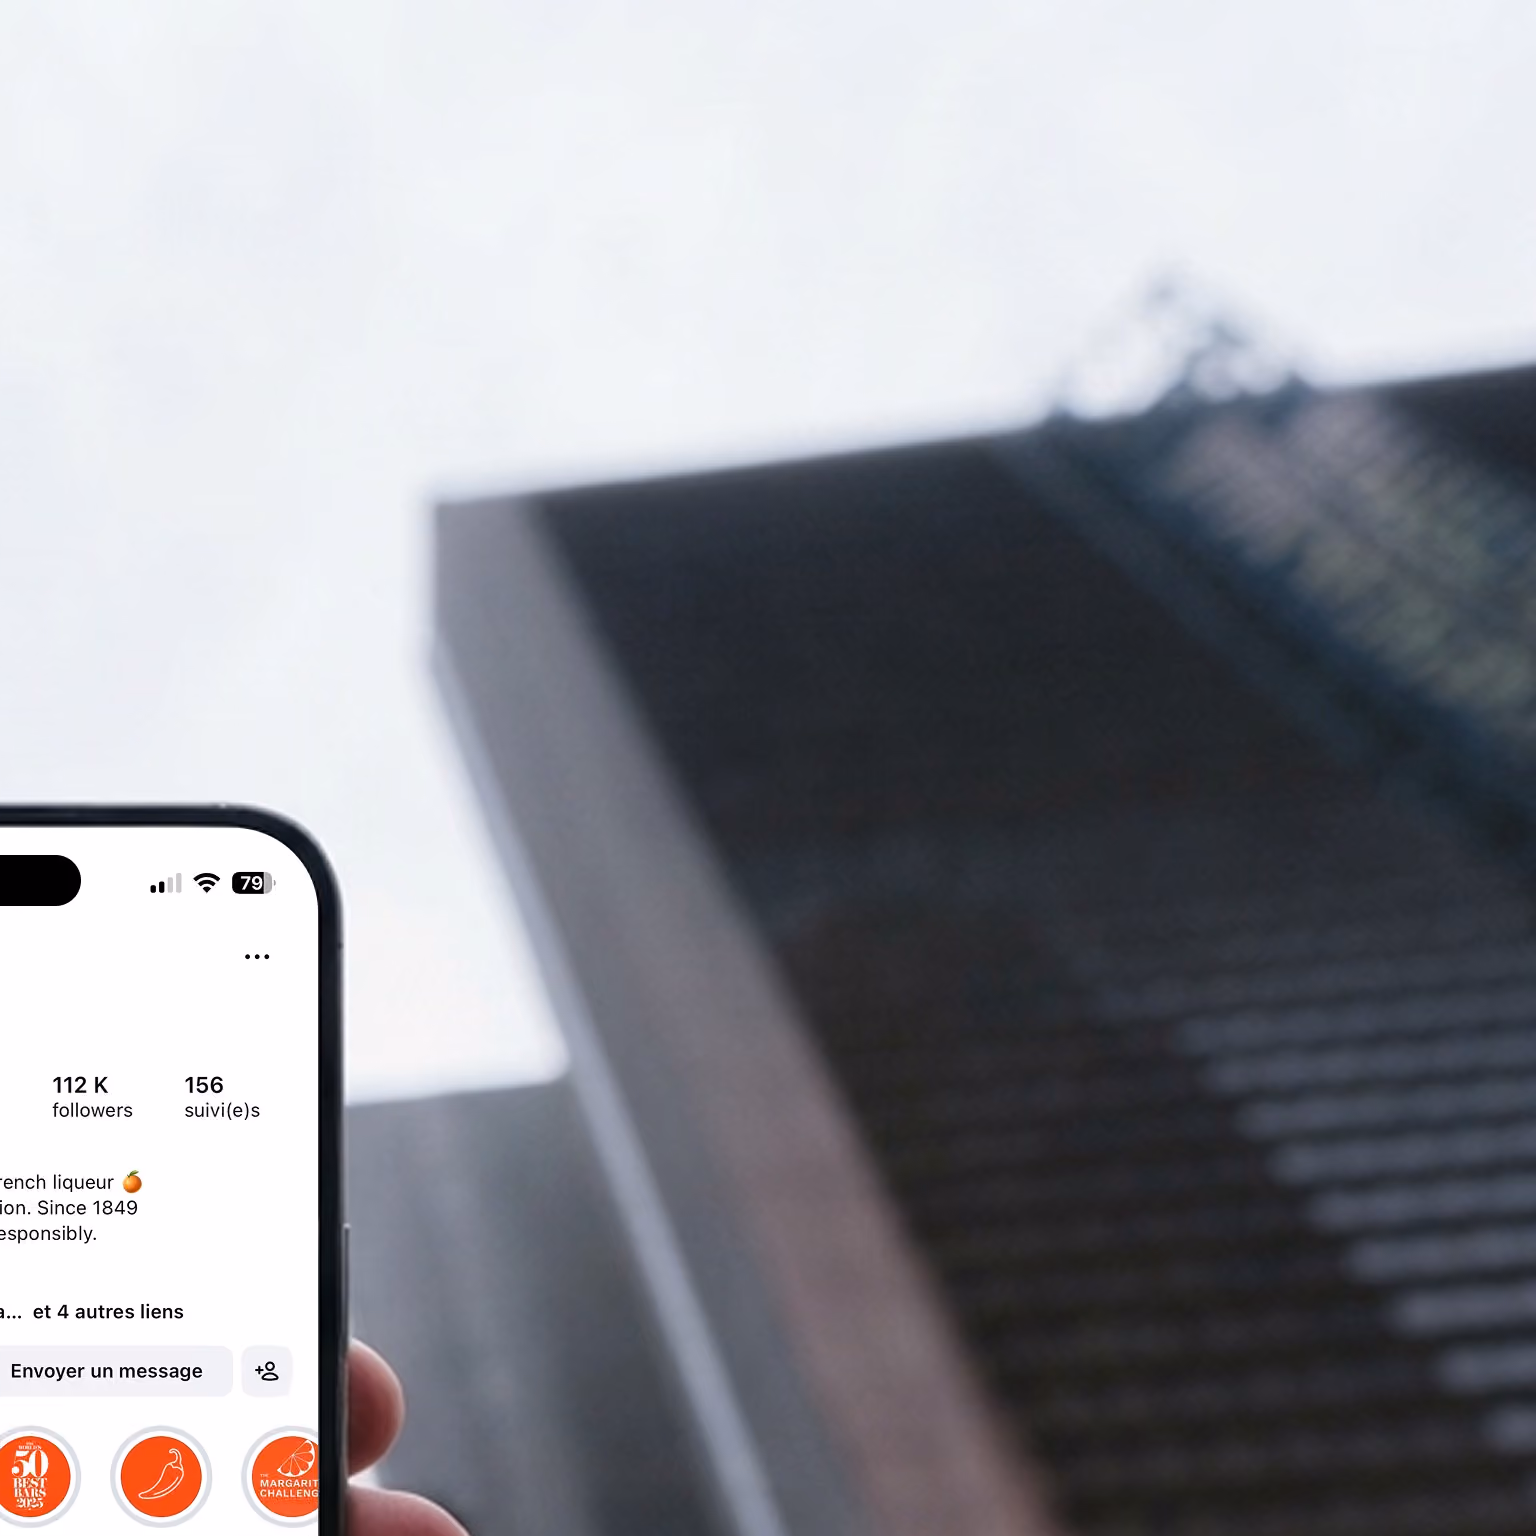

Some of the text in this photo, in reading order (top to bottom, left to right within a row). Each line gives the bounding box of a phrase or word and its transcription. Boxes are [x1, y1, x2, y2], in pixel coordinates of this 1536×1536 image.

[240, 875, 263, 891] 79
[52, 1076, 109, 1094] 112 K
[184, 1076, 224, 1094] 156
[52, 1101, 133, 1118] followers
[184, 1101, 261, 1121] suivi(e)s
[53, 1173, 115, 1193] liqueur
[37, 1199, 87, 1216] Since
[92, 1199, 138, 1216] 1849
[33, 1304, 52, 1320] et
[57, 1304, 70, 1319] 4
[74, 1304, 135, 1320] autres
[140, 1303, 184, 1320] liens
[11, 1363, 203, 1382] Envoyer un message
[12, 1450, 49, 1478] 50
[13, 1478, 48, 1488] BEST
[14, 1488, 46, 1498] BARS
[16, 1498, 44, 1508] 2025
